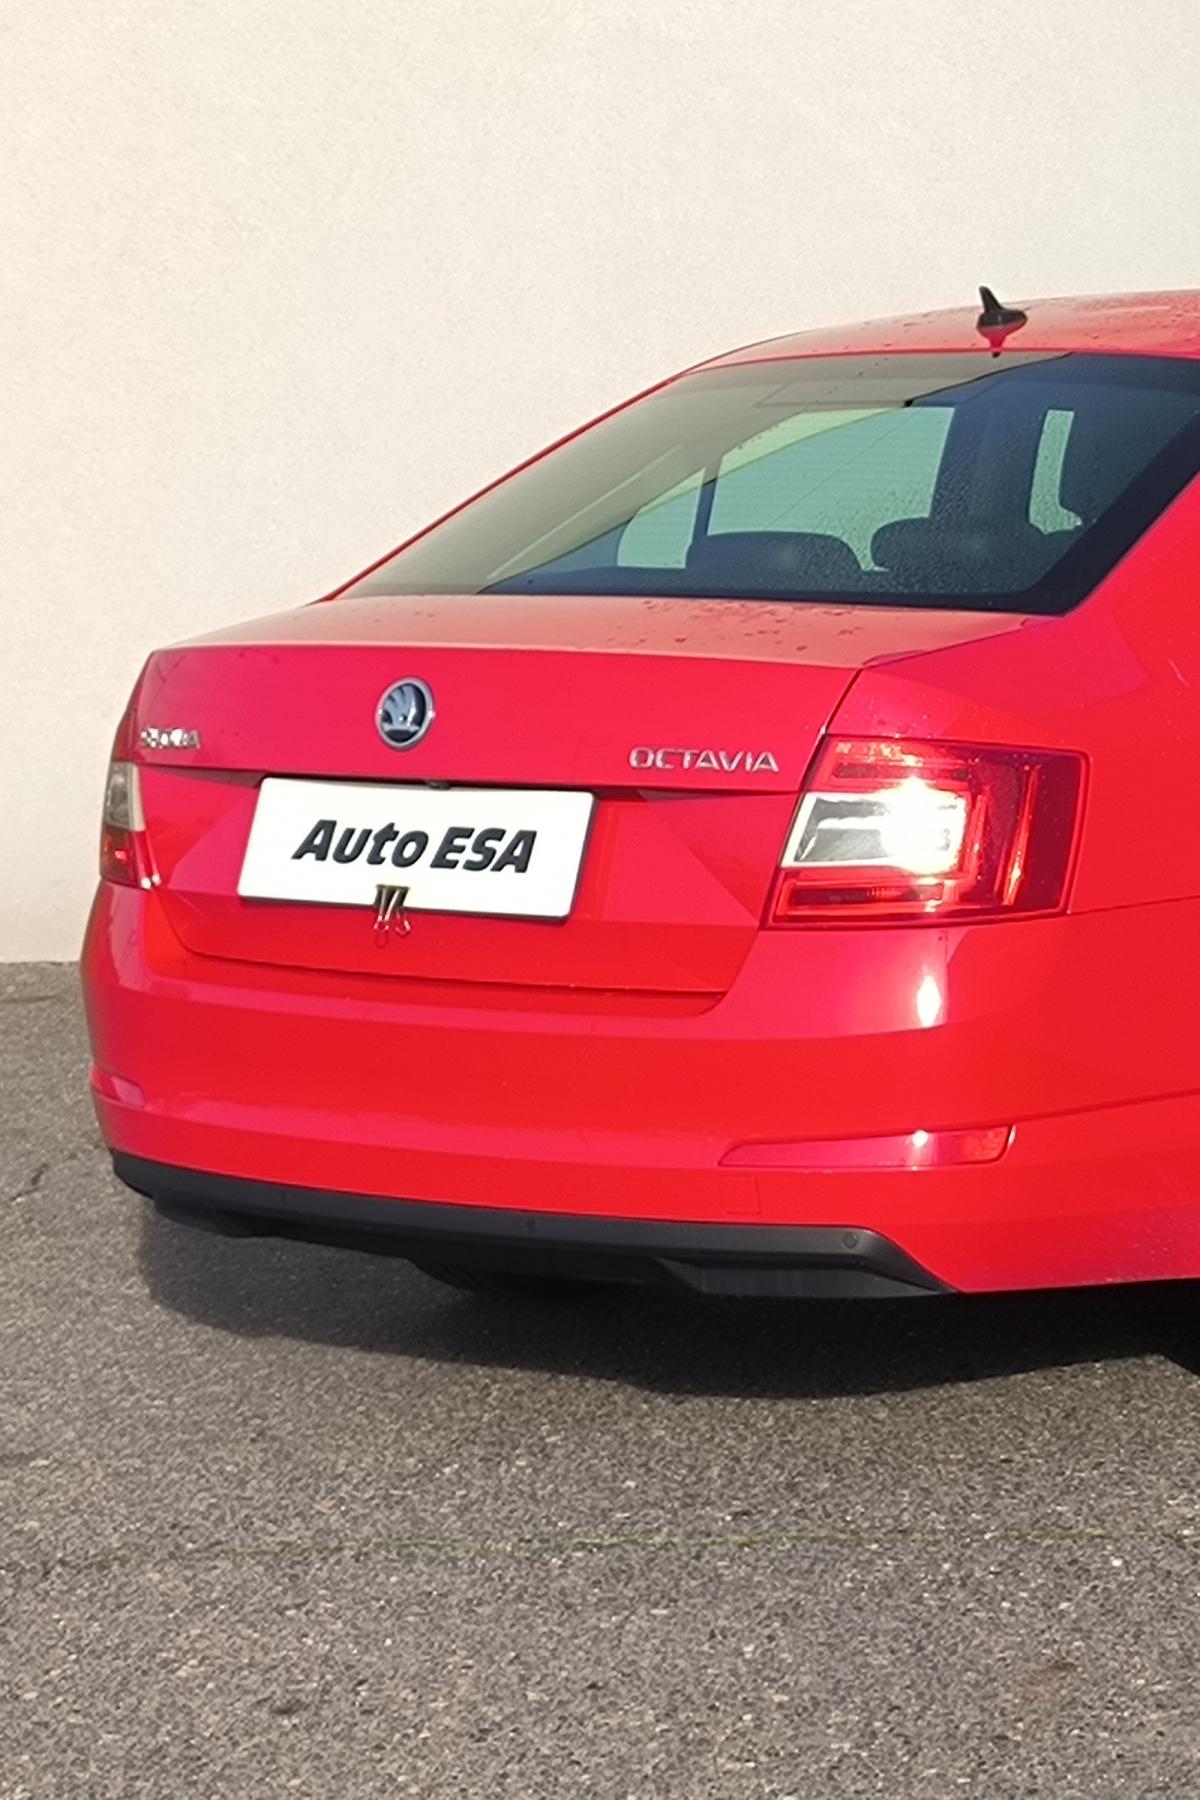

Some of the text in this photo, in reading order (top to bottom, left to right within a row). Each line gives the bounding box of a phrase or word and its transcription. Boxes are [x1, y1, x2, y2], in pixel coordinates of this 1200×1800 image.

[628, 747, 780, 773] OCTAVIA
[291, 819, 538, 873] Auto ESA
